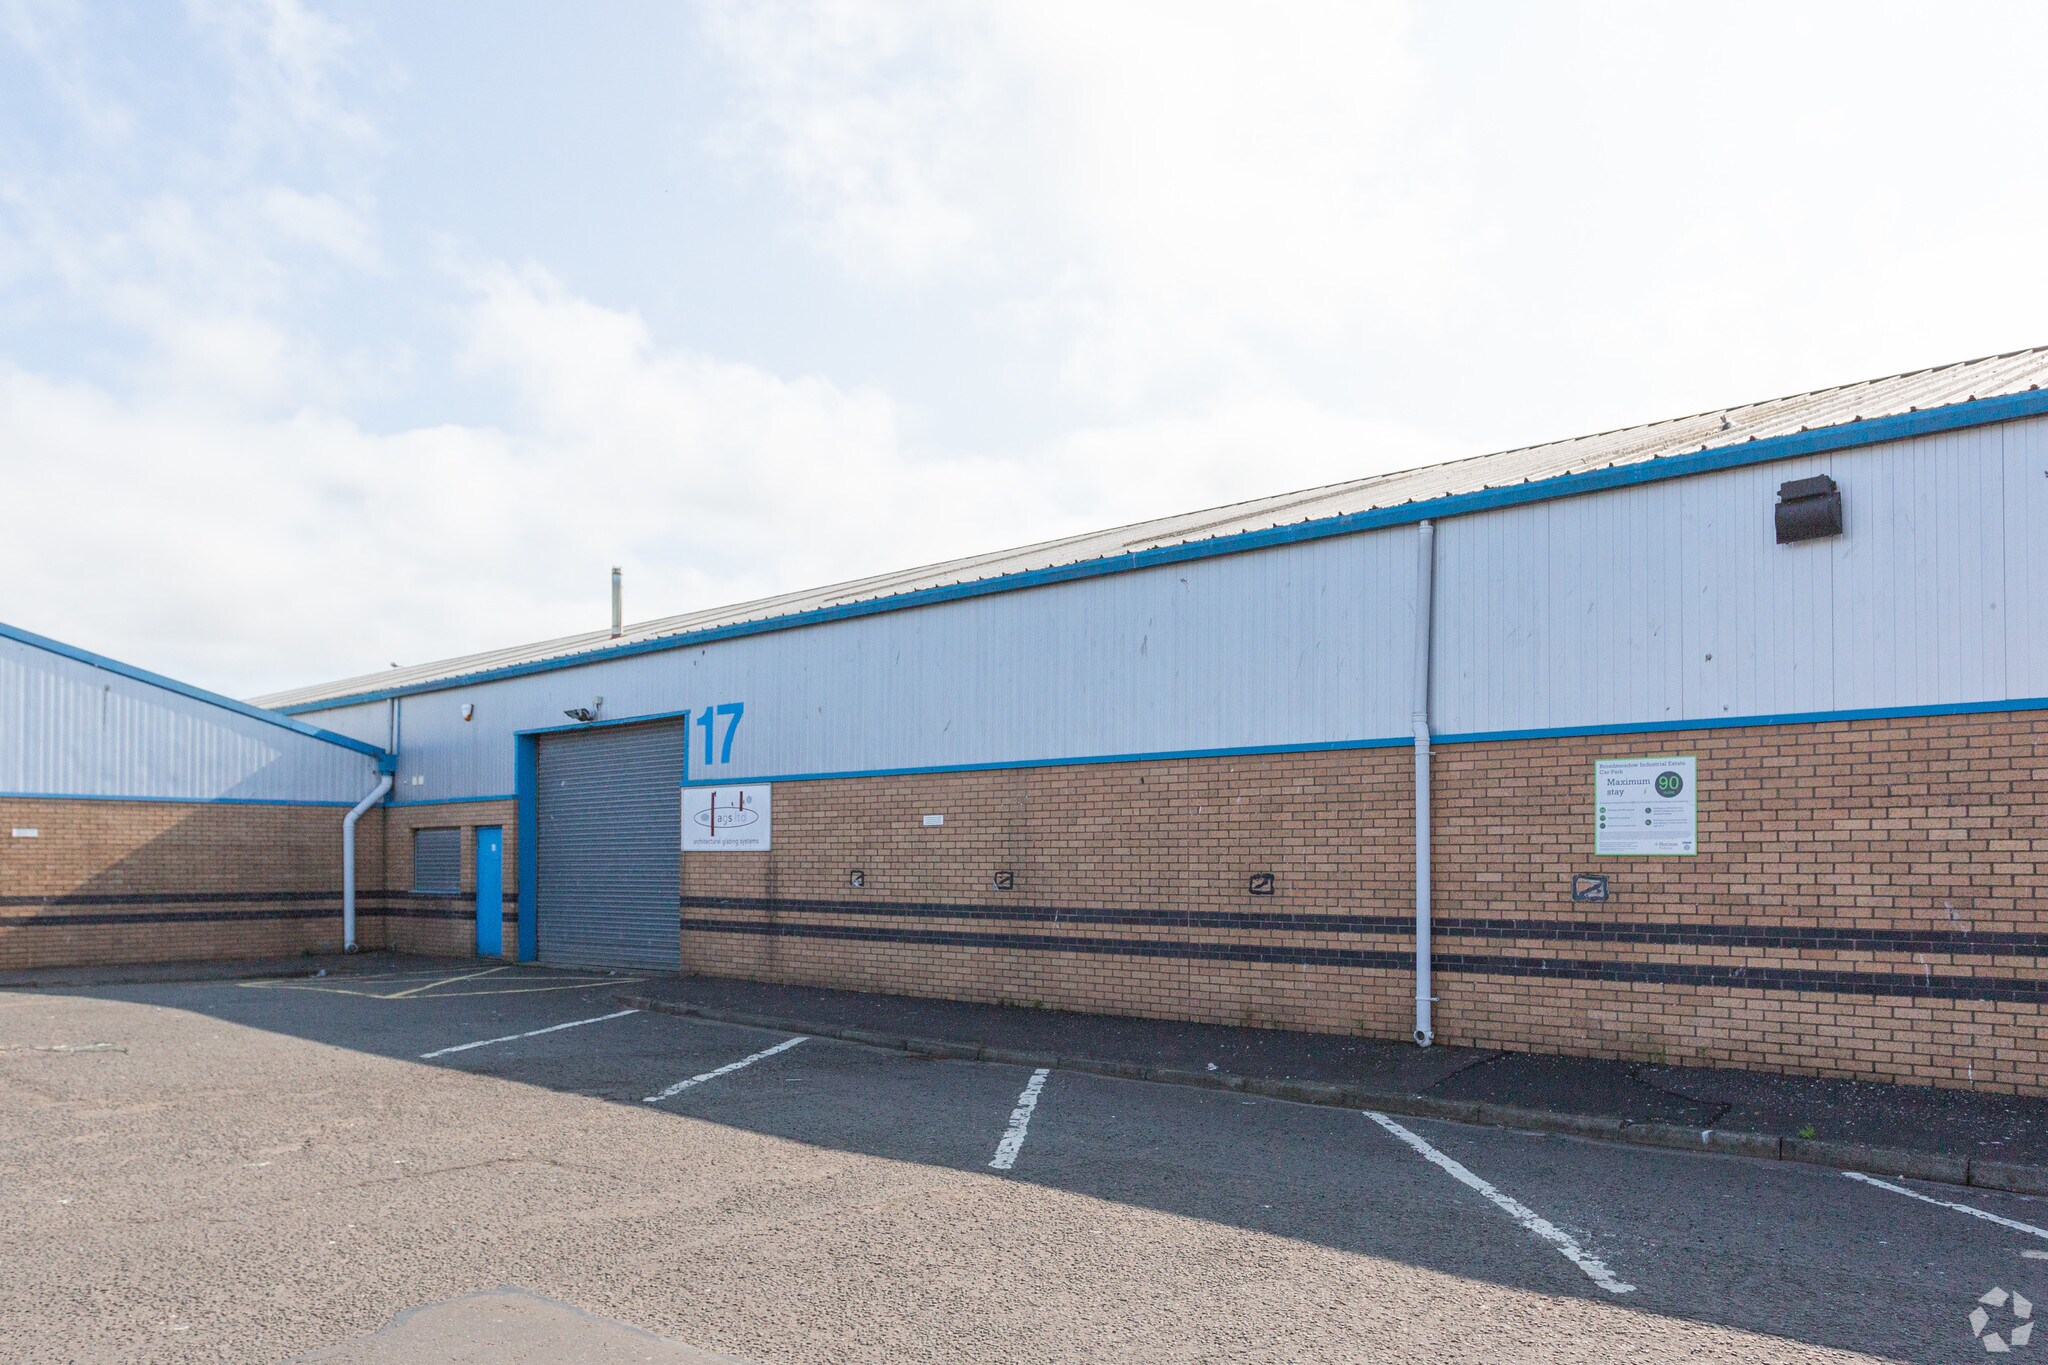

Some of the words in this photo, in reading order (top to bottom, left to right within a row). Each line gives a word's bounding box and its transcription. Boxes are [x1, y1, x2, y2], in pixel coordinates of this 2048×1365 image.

[696, 702, 744, 765] 17
[1606, 778, 1651, 786] Maximum
[1658, 775, 1680, 790] 90
[1606, 788, 1625, 797] stay
[717, 814, 733, 825] ags
[735, 811, 747, 823] ltd
[693, 838, 721, 846] architectural
[722, 838, 739, 847] glazing
[739, 837, 759, 846] systems
